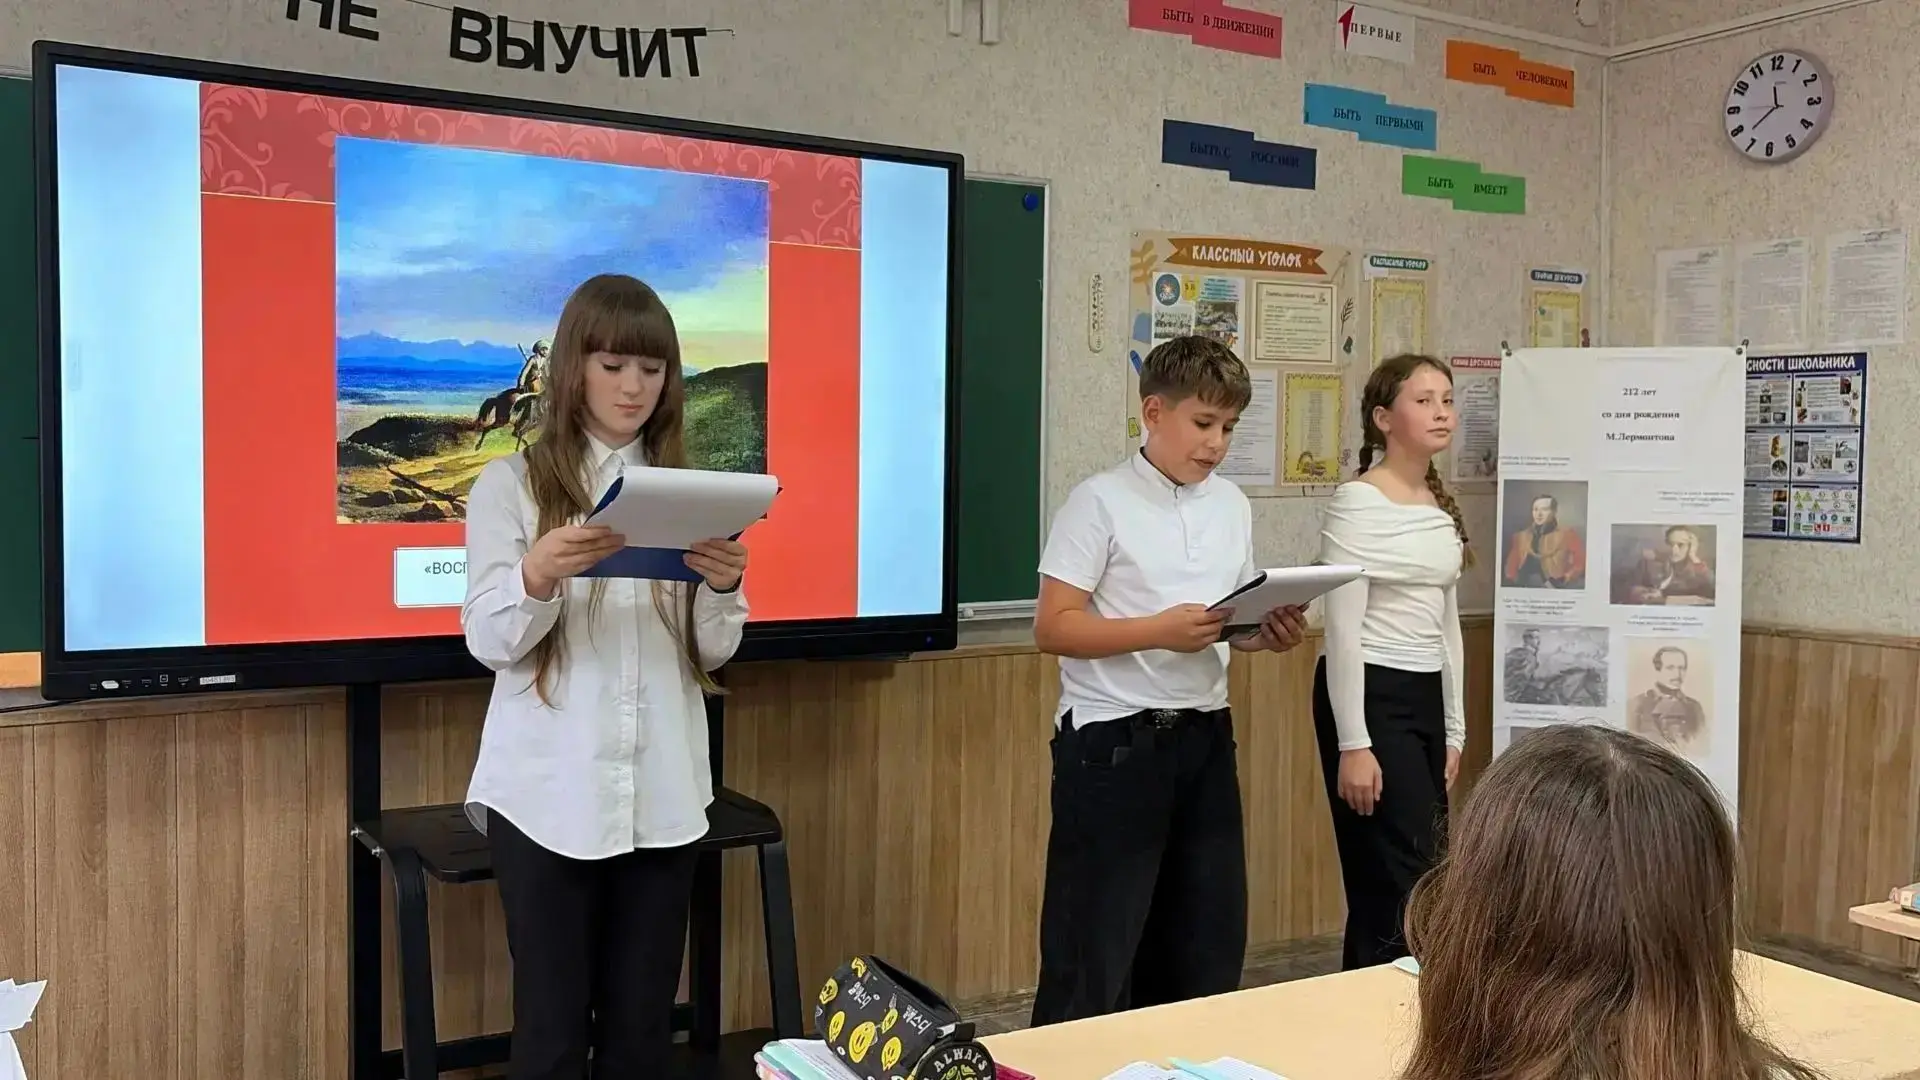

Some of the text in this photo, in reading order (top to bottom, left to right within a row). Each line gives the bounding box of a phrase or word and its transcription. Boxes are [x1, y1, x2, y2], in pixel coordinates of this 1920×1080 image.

[1162, 8, 1274, 38] БЫТЬ В ДВИЖЕНИИ
[1350, 22, 1402, 43] ПЕРВЫЕ
[449, 6, 707, 78] ВЫУЧИТ
[1749, 62, 1764, 79] 11
[1771, 54, 1784, 71] 12
[1791, 59, 1802, 73] 1
[1473, 62, 1568, 90] БЫТЬ ЧЕЛОВЕКОМ
[1803, 73, 1817, 87] 2
[1733, 80, 1749, 96] 10
[1807, 96, 1822, 106] 3
[1727, 105, 1740, 115] 9
[1333, 107, 1424, 132] БЫТЬ ПЕРВЫМИ
[1800, 118, 1814, 130] 4
[1730, 125, 1744, 137] 8
[1190, 140, 1223, 156] БЫТЬ
[1745, 137, 1757, 152] 7
[1765, 141, 1774, 157] 6
[1785, 134, 1796, 148] 5
[1428, 176, 1508, 195] БЫТЬ ВМЕСТЕ
[1192, 245, 1302, 268] КЛАССНЫЙ УГОЛОК
[1746, 355, 1856, 372] СНОСТИ ШКОЛЬНИКА
[1622, 387, 1639, 396] 212
[1633, 412, 1680, 420] рождения
[1606, 432, 1675, 442] М.Лермонтова
[934, 1047, 988, 1073] ALWAYS
